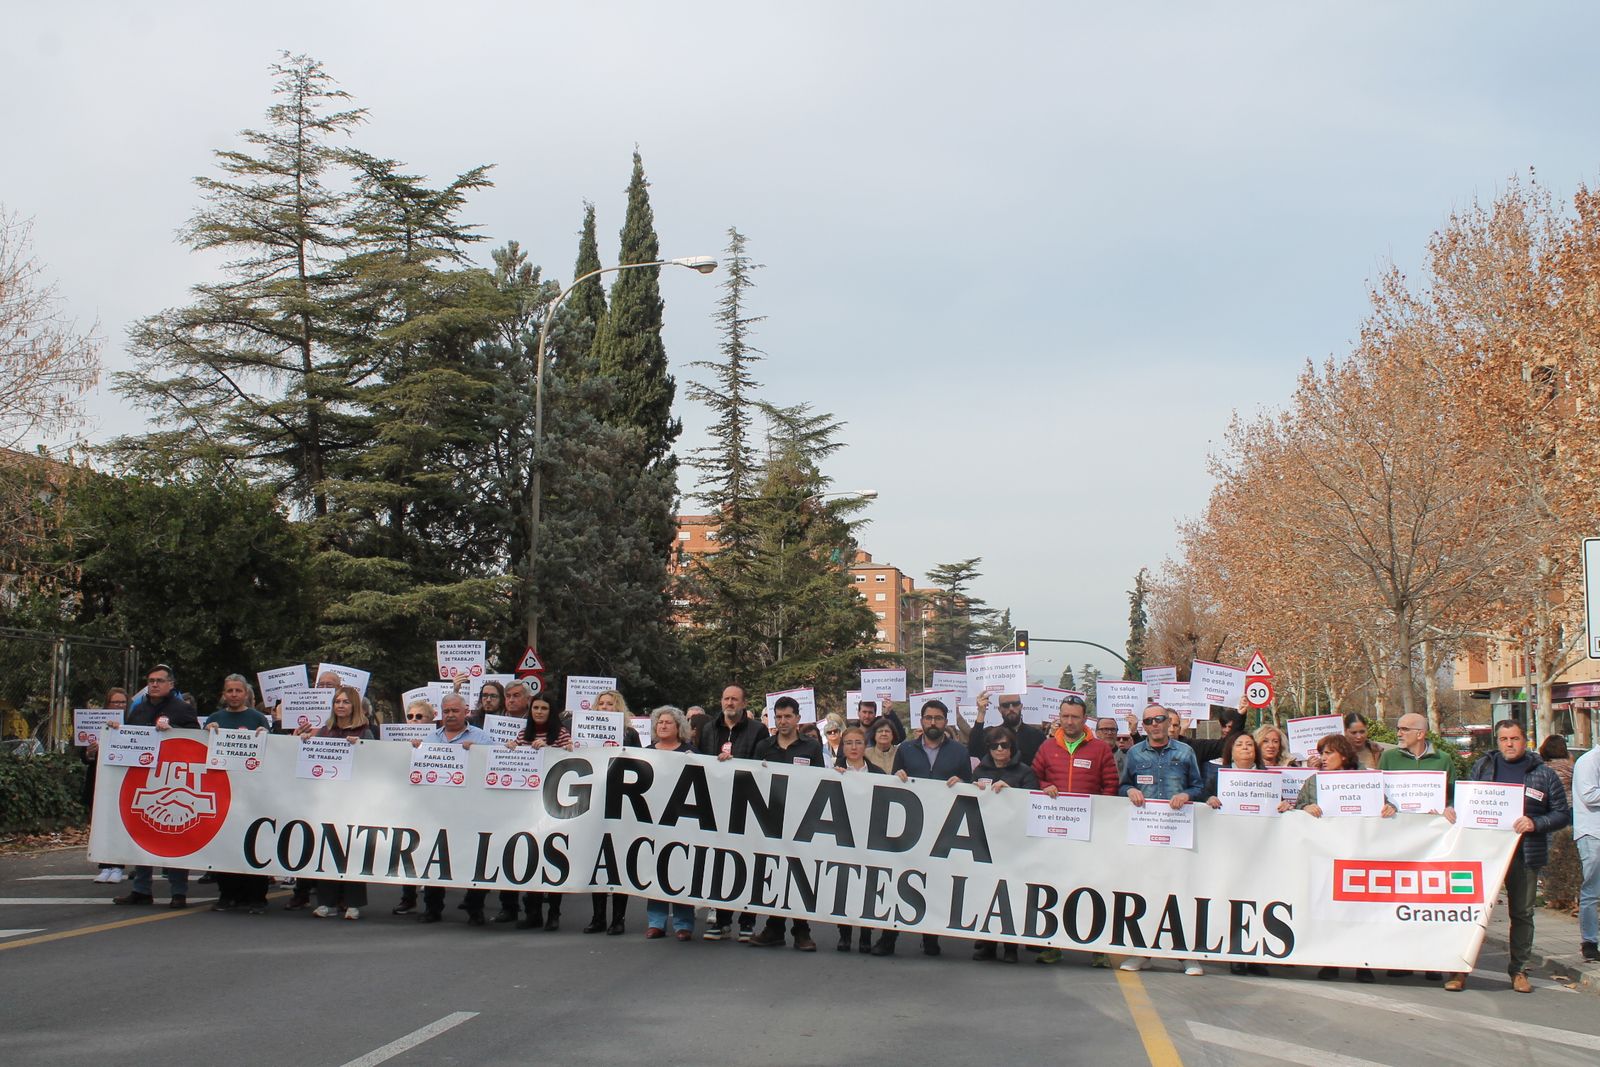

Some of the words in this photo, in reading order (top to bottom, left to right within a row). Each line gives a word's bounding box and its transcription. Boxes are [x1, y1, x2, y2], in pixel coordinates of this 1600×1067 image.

[268, 672, 295, 680] DENUNCIA
[1204, 687, 1229, 695] nómina
[1250, 689, 1266, 698] 30
[150, 761, 207, 792] UGT
[1230, 780, 1272, 788] Solidaridad
[1332, 782, 1380, 791] precariedad
[1250, 791, 1279, 799] familias
[542, 756, 993, 864] GRANADA
[1342, 868, 1447, 894] CCOO
[243, 817, 454, 881] CONTRA
[471, 831, 571, 887] LOS
[588, 832, 927, 925] ACCIDENTES
[945, 874, 1296, 959] LABORALES
